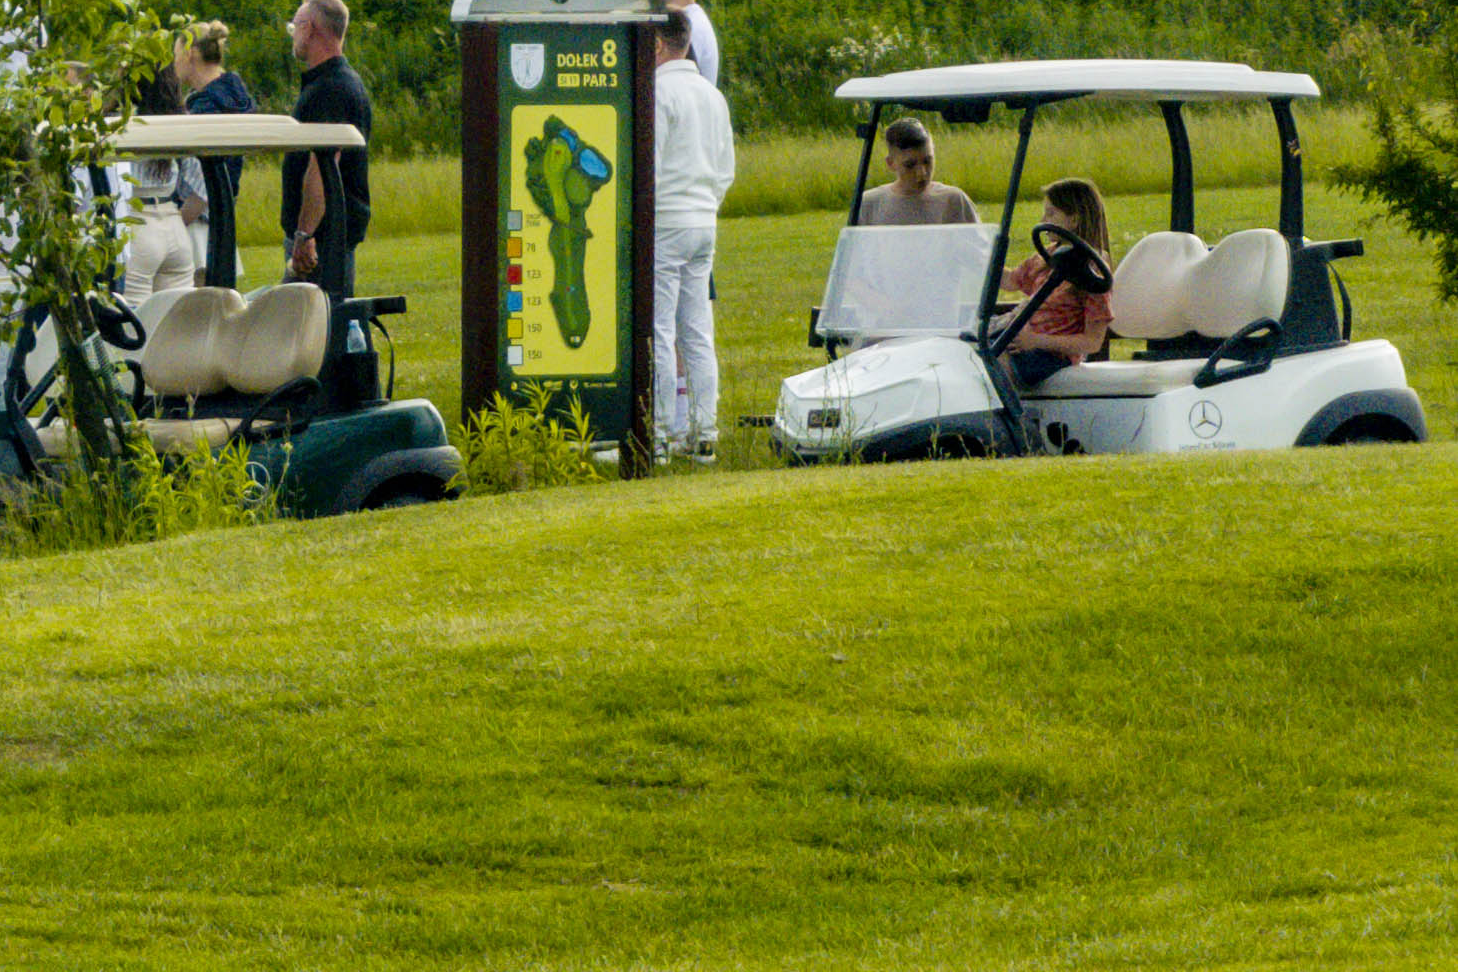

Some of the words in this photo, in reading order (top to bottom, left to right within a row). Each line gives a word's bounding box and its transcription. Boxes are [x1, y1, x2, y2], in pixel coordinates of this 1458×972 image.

[557, 53, 598, 67] DOŁEK
[602, 39, 617, 67] 8
[583, 73, 607, 87] PAR
[610, 73, 618, 87] 3
